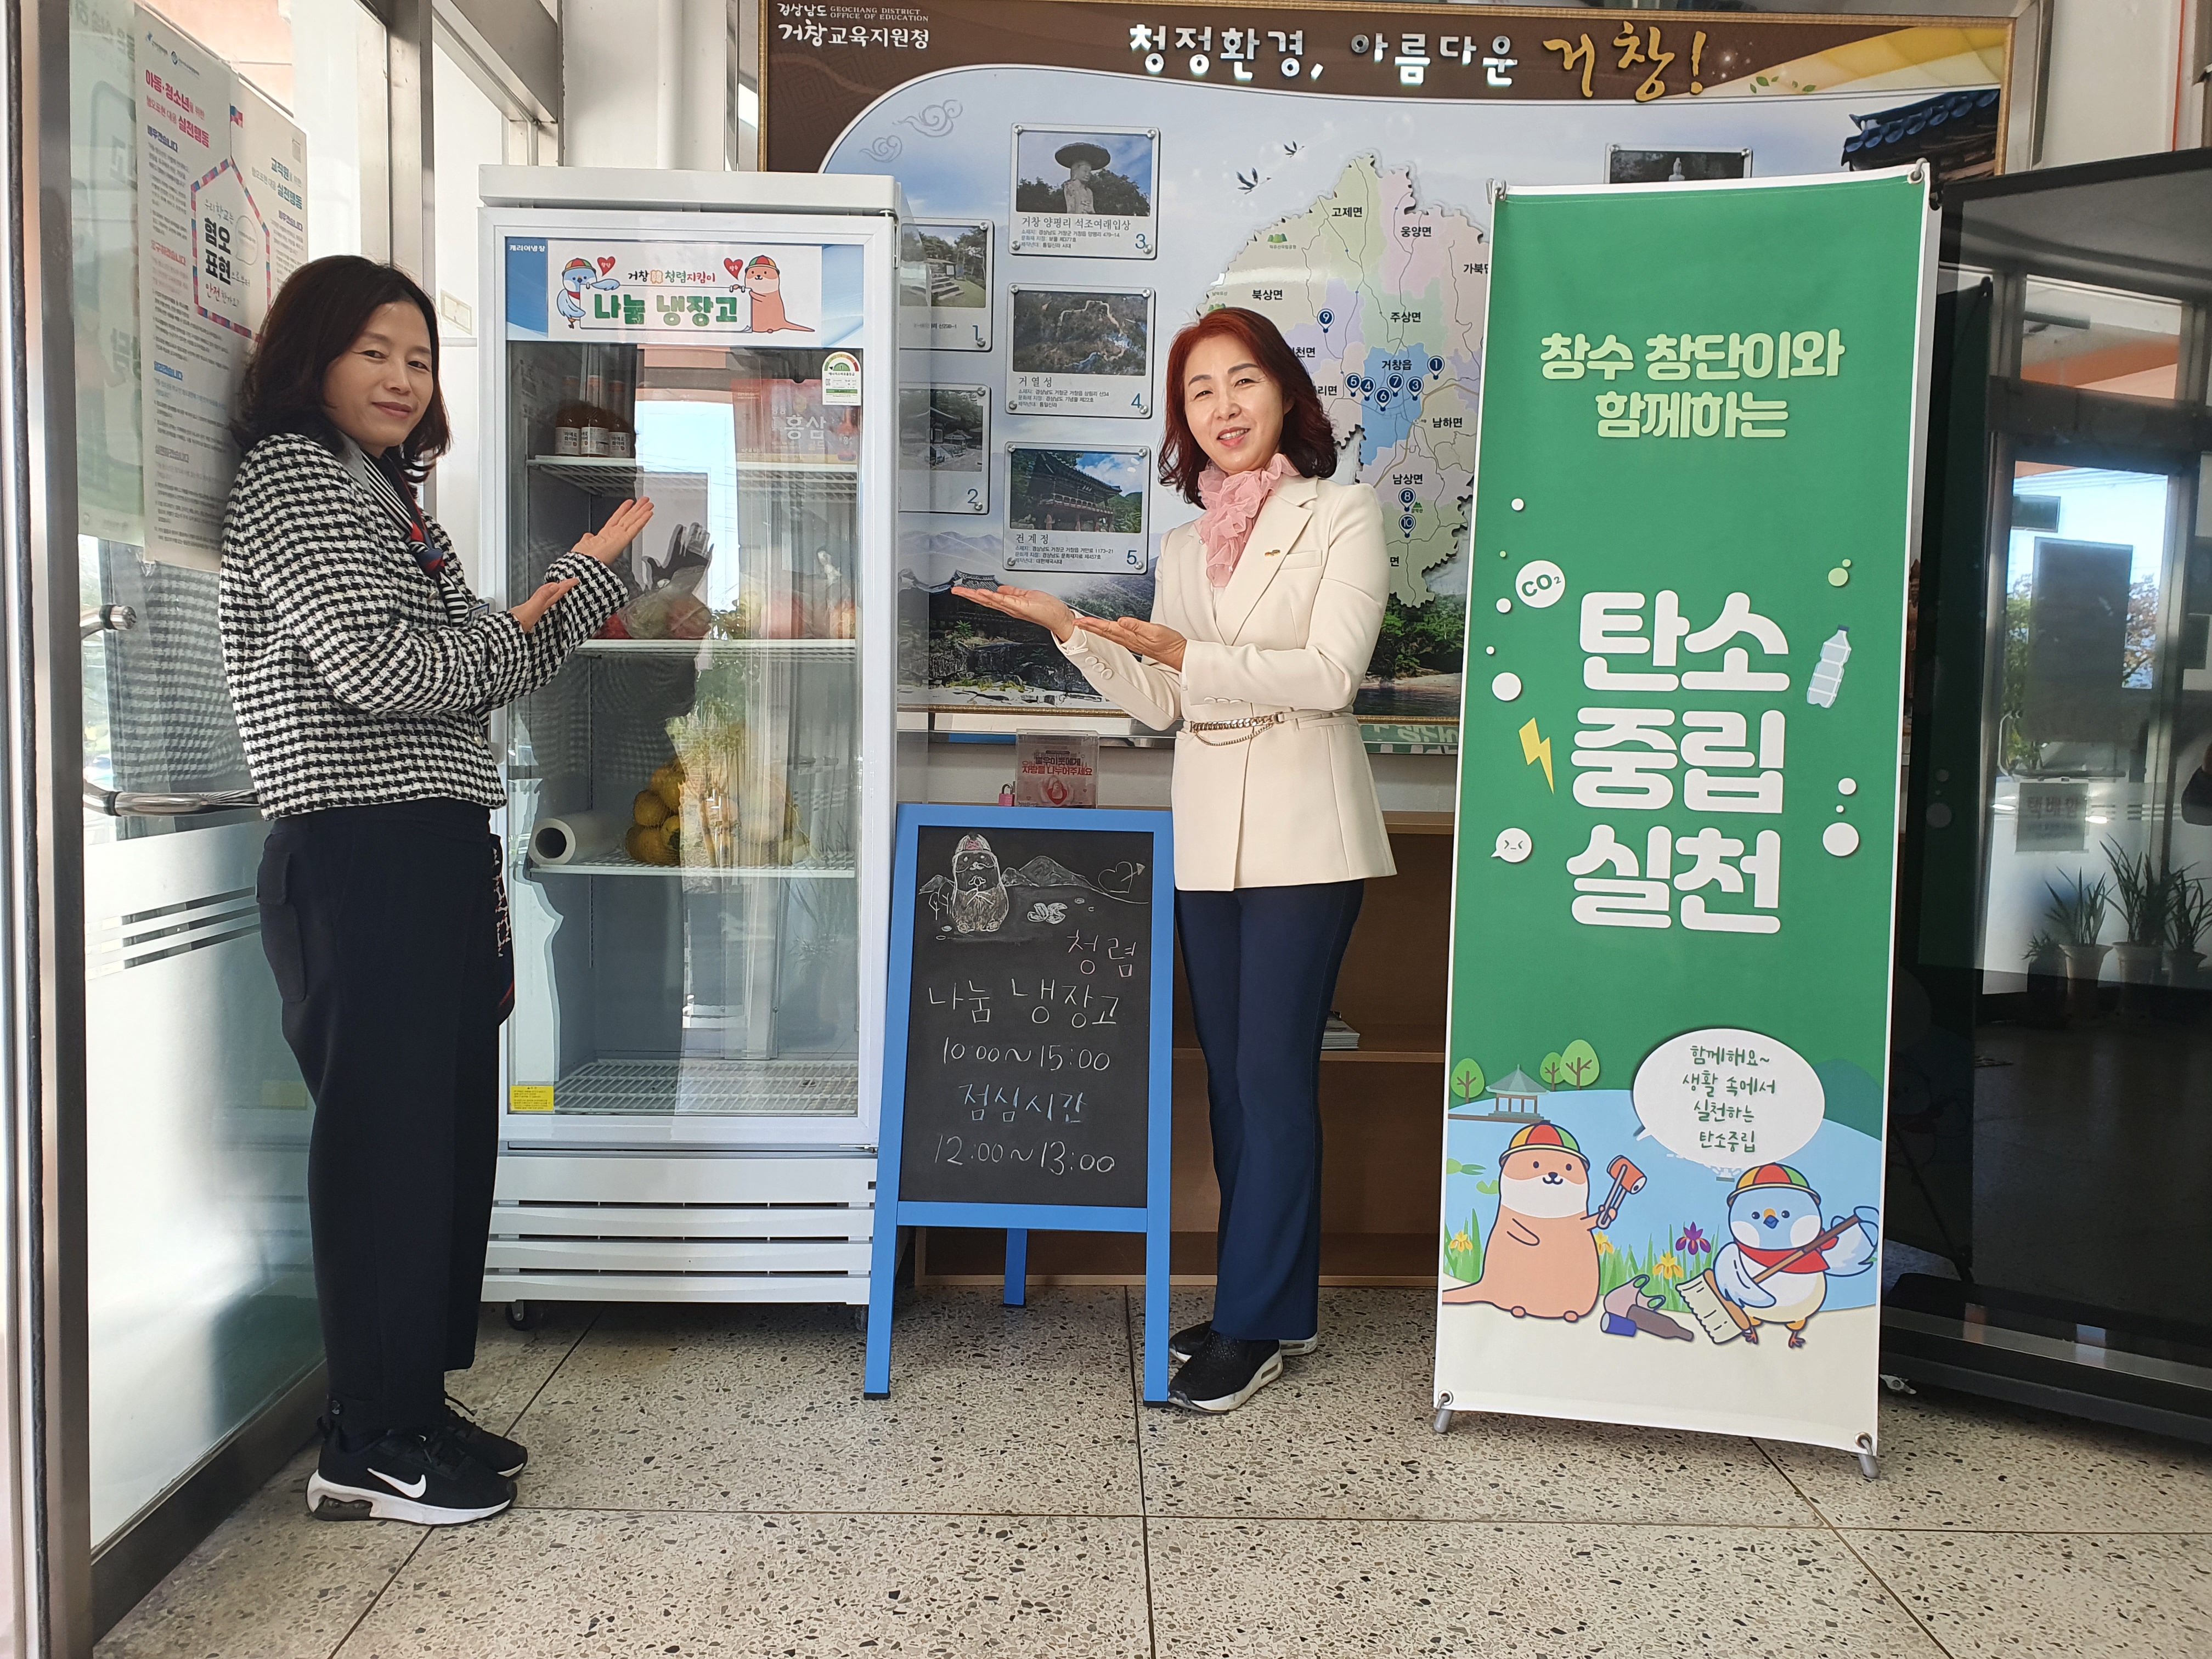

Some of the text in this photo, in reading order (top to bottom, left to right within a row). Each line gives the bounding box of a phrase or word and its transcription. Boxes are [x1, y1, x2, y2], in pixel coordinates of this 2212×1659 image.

[777, 3, 827, 17] 경상남도
[778, 19, 929, 49] 거창교육지원청
[1129, 20, 1707, 103] 청정환경, 아름다운 거창!
[178, 115, 210, 148] 실천행동
[1331, 207, 1362, 217] 고제면
[1022, 216, 1131, 231] 거창 양평리 석조여래입상
[204, 217, 232, 255] 혐오
[1401, 226, 1432, 238] 웅양면
[1135, 233, 1146, 249] 3
[628, 270, 650, 283] 거창
[664, 270, 716, 284] 청렴지킴이
[1252, 289, 1283, 301] 북상면
[594, 294, 737, 327] 나눔 냉장고
[1322, 313, 1330, 323] 9
[1390, 312, 1421, 323] 주상면
[1293, 347, 1316, 358] 천면
[1540, 328, 1846, 381] 창수 창단이와
[1381, 359, 1412, 370] 거창읍
[1350, 377, 1357, 386] 5
[1364, 381, 1371, 390] 4
[1392, 376, 1399, 386] 7
[1412, 381, 1419, 390] 3
[1131, 393, 1142, 409] 4
[1380, 392, 1387, 401] 6
[1432, 417, 1463, 428] 남하면
[1595, 390, 1789, 439] 함께하는
[784, 414, 827, 439] 홍삼
[1392, 473, 1423, 485] 남상면
[967, 488, 978, 504] 2
[1404, 492, 1410, 501] 8
[1403, 518, 1413, 527] 10
[1126, 550, 1137, 565] 5
[1578, 589, 1791, 692] 탄소
[1570, 707, 1786, 814] 중립
[1565, 823, 1782, 934] 실천
[1066, 928, 1136, 978] 청렴
[928, 978, 1119, 1029] 나눔 냉장고
[1689, 1045, 1770, 1066] 함께해요~
[1682, 1070, 1776, 1098] 생활 속에서
[958, 1083, 1088, 1124] 점심시간
[1693, 1099, 1755, 1123] 실천하는
[1699, 1130, 1756, 1153] 탄소중립
